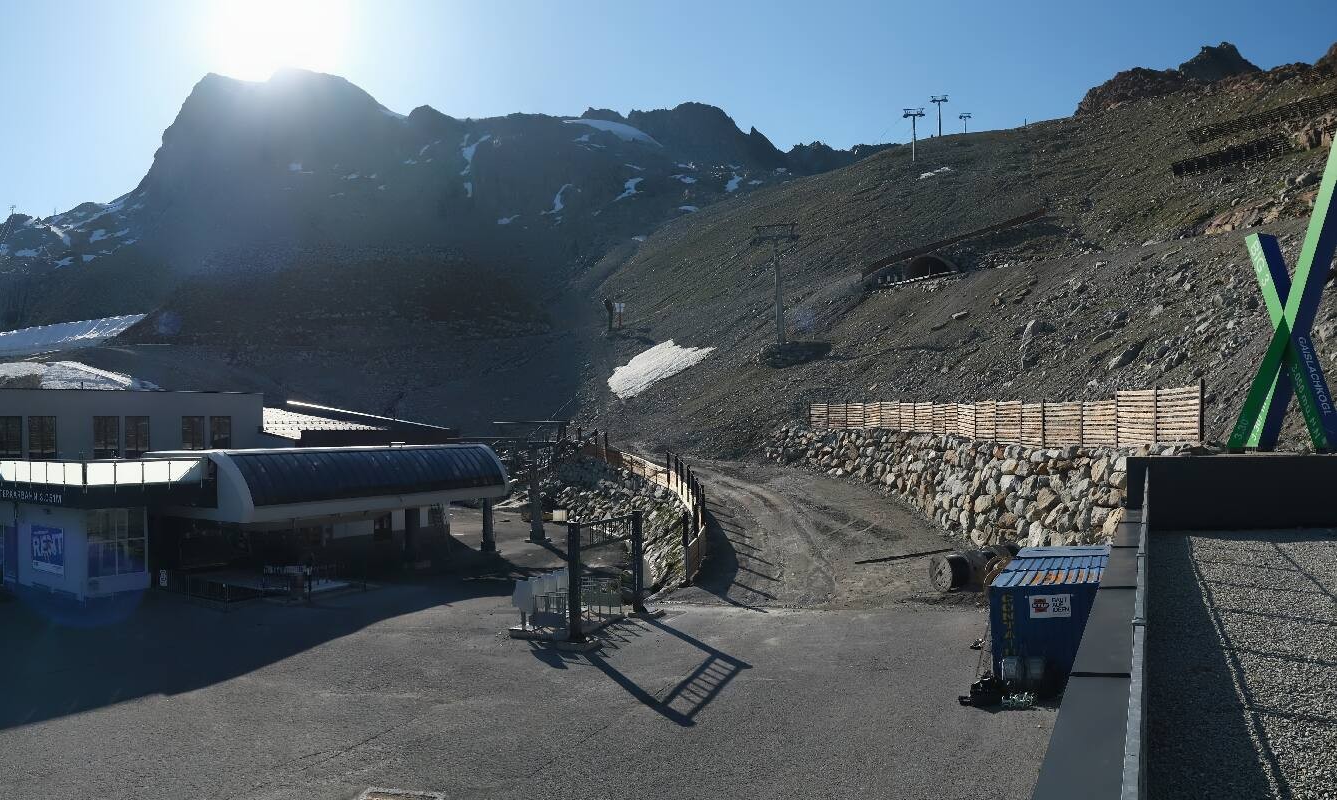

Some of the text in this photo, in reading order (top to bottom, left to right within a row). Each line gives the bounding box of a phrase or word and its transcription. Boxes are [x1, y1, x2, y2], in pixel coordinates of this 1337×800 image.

[1251, 240, 1269, 286] BIG 3
[1298, 336, 1331, 416] GAISLACHKOGL
[32, 533, 63, 557] RENT
